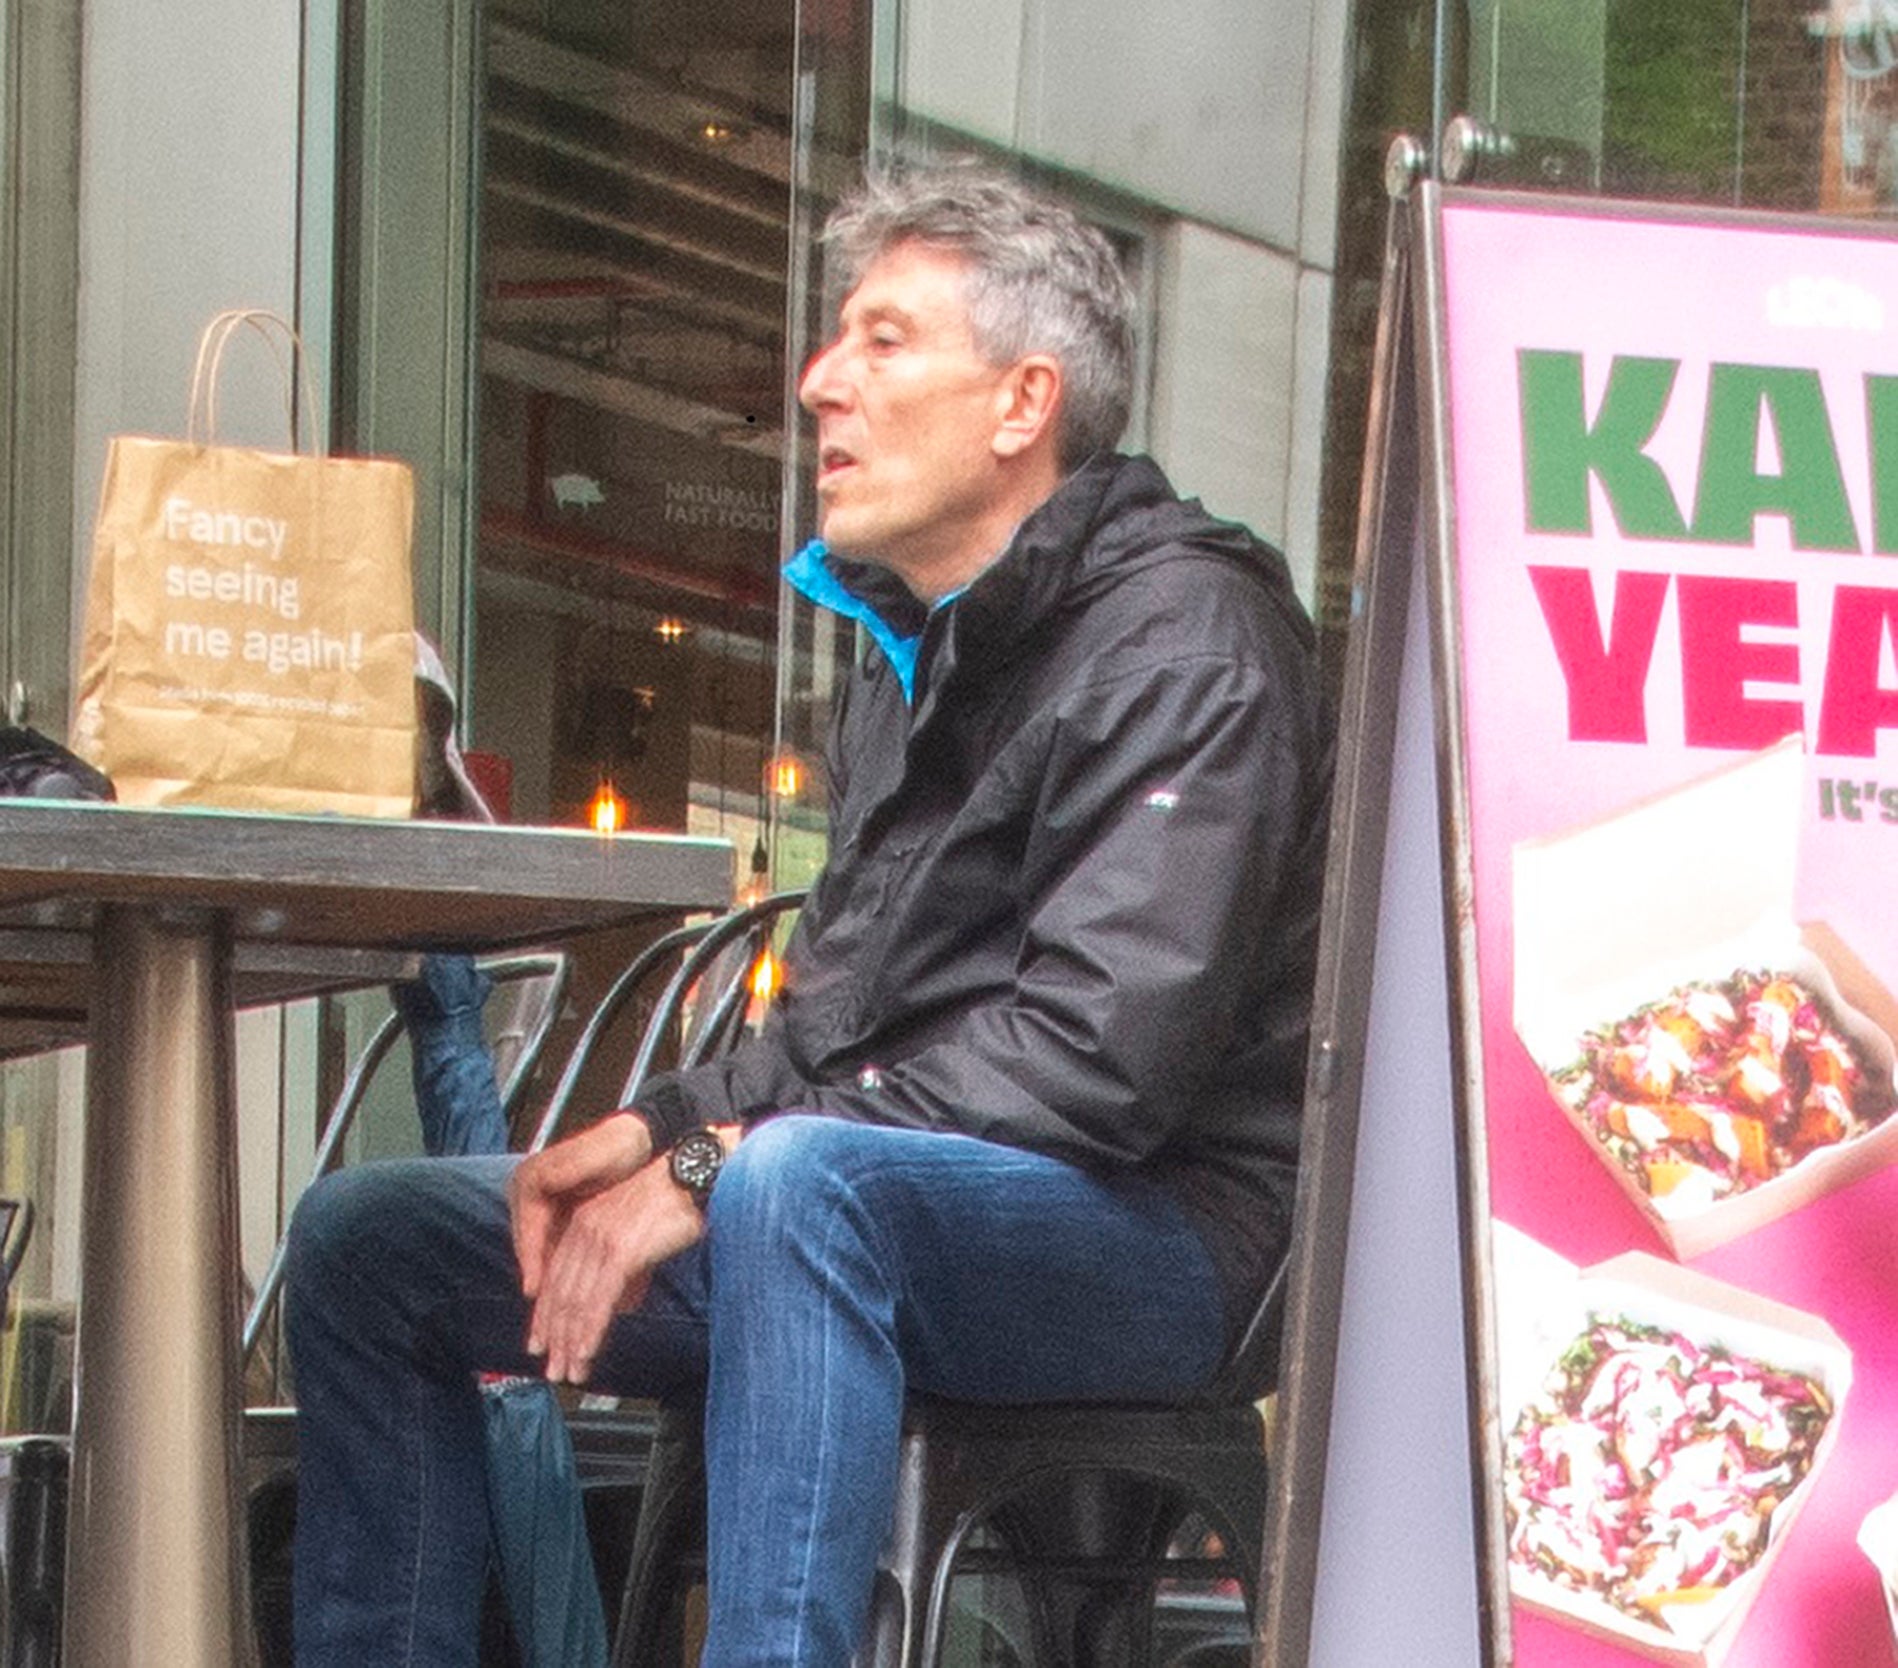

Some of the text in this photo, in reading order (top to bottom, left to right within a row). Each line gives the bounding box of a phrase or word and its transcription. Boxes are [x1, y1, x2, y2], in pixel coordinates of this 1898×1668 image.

[165, 497, 286, 560] Fancy
[665, 503, 778, 532] FAST FOOD
[165, 562, 300, 619] seeing
[166, 621, 364, 673] me again!
[1526, 565, 1898, 757] YEA
[1818, 778, 1898, 824] It's
